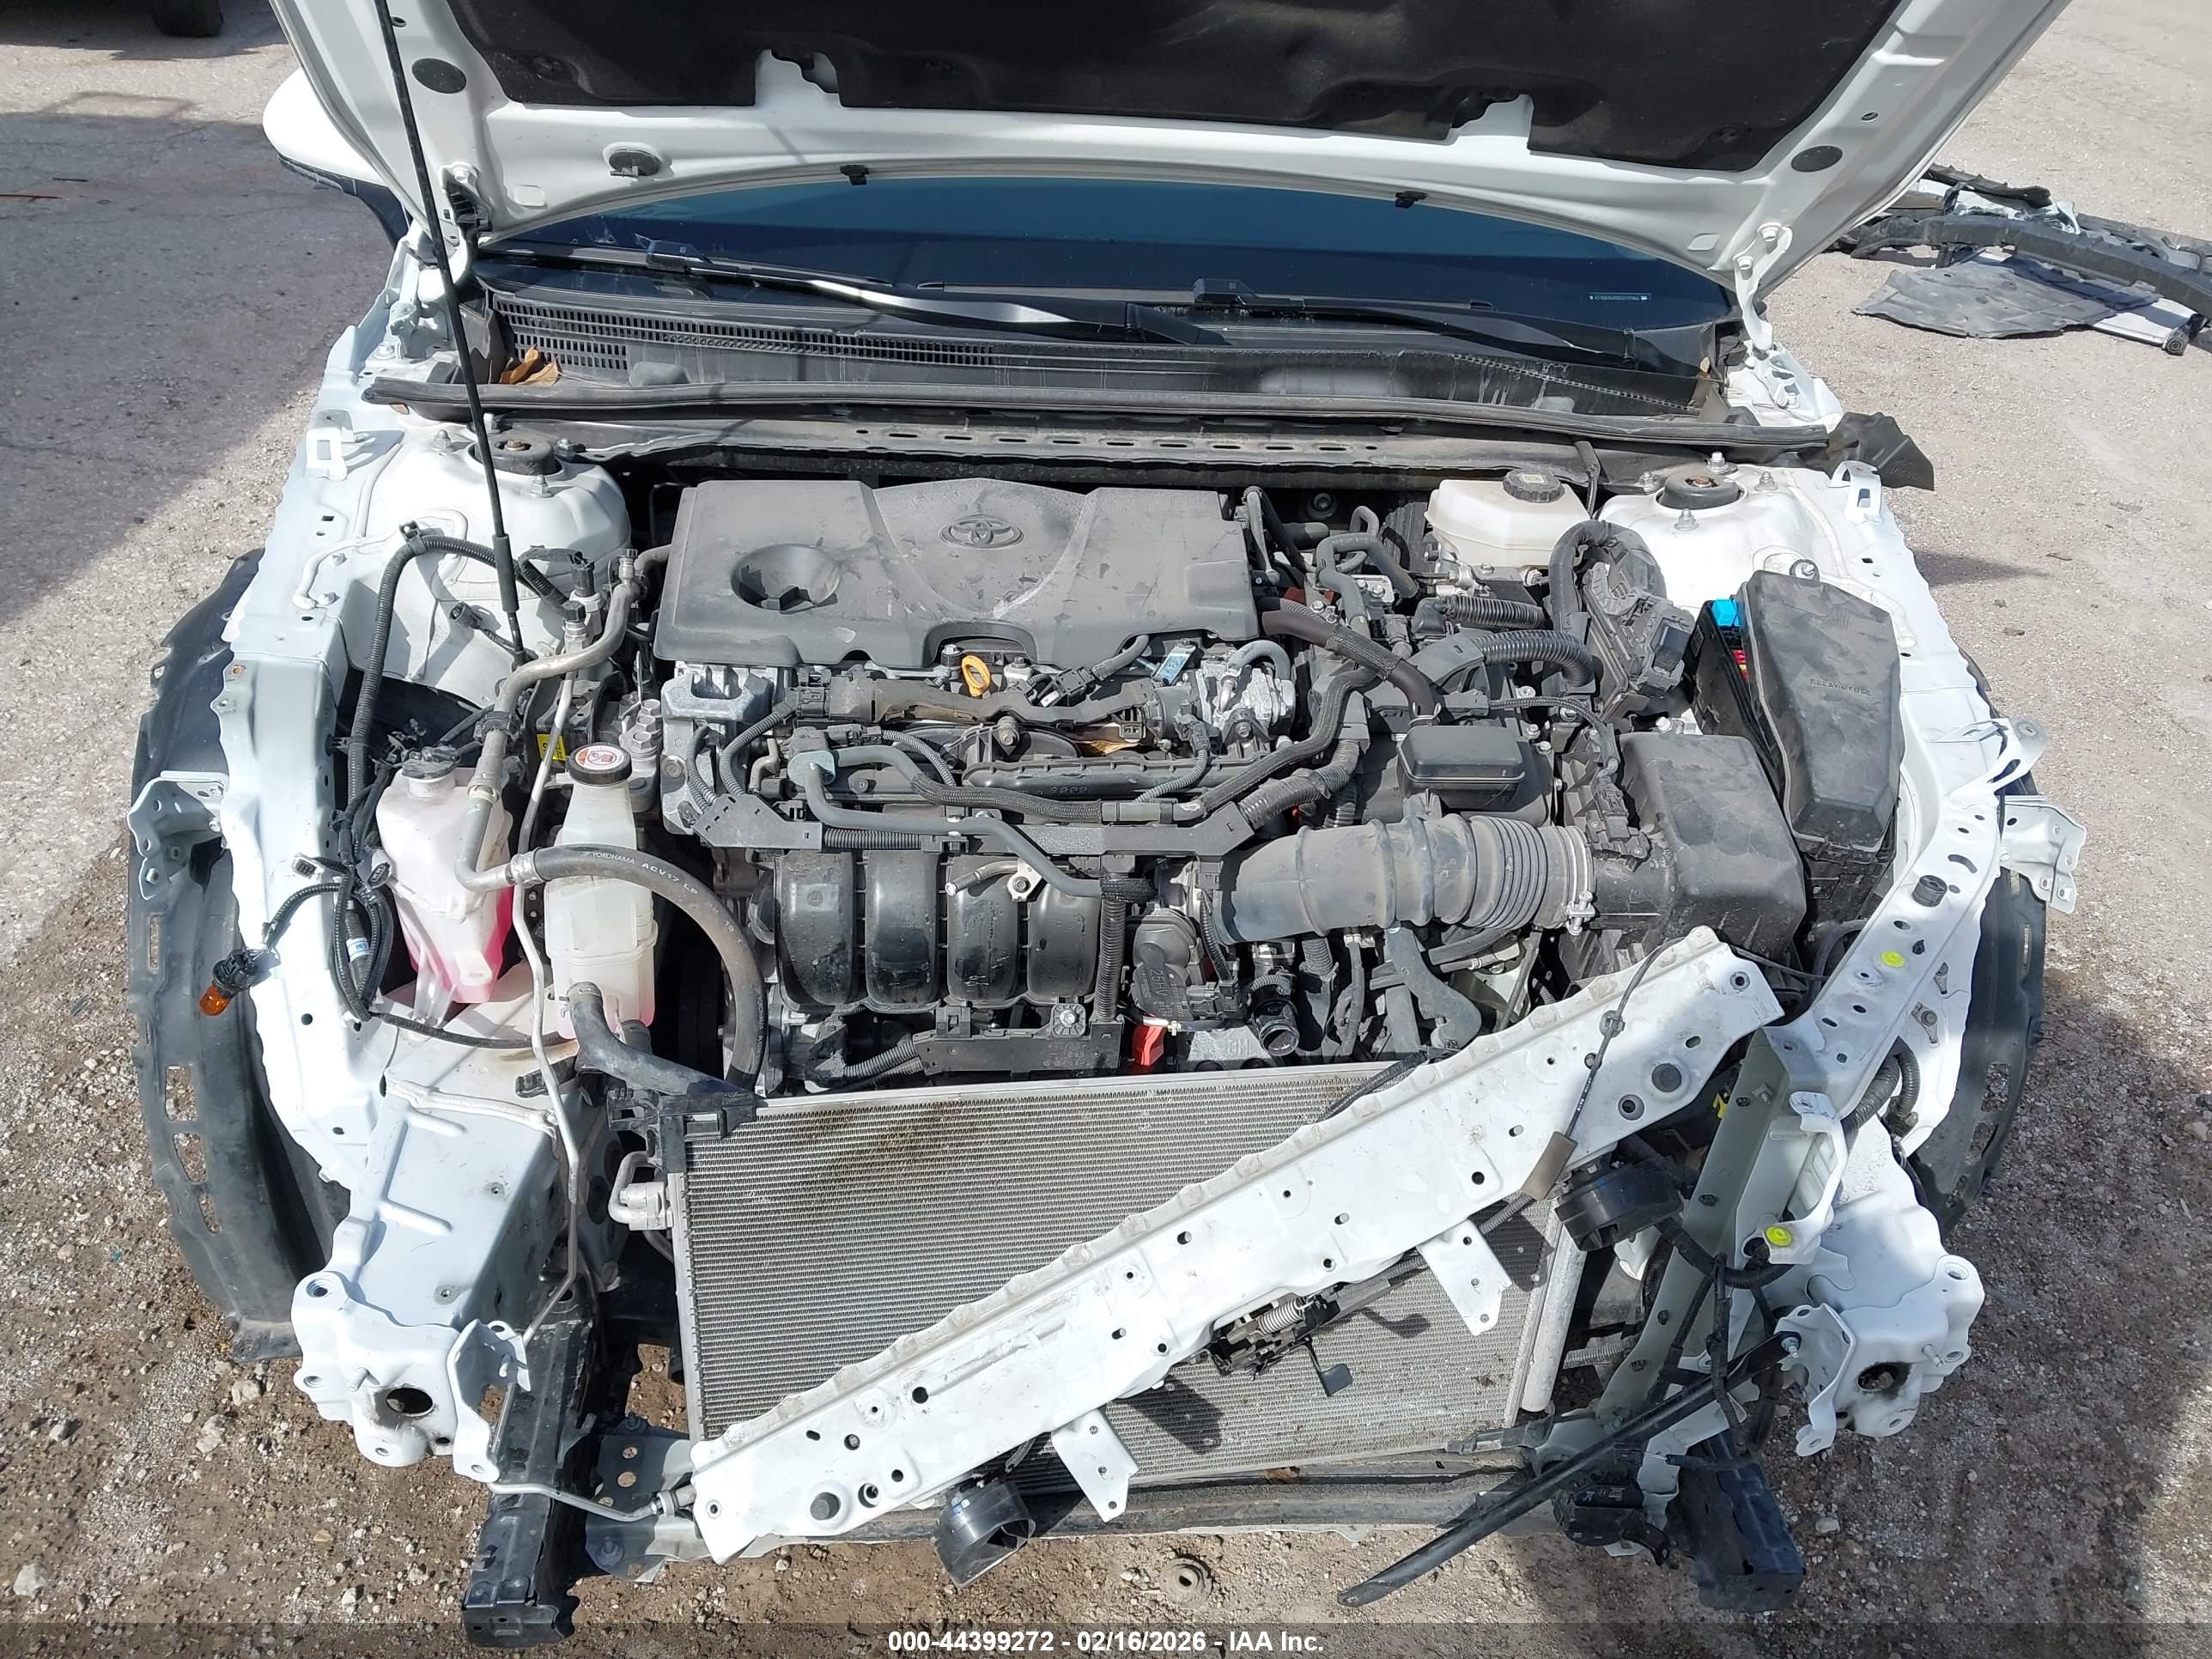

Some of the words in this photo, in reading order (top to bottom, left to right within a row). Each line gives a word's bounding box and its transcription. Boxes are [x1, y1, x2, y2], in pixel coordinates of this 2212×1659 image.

[1809, 678, 1838, 690] RELAY
[1848, 685, 1873, 696] FUSE
[592, 851, 635, 866] YOKOHAMA
[641, 862, 680, 882] ACV17
